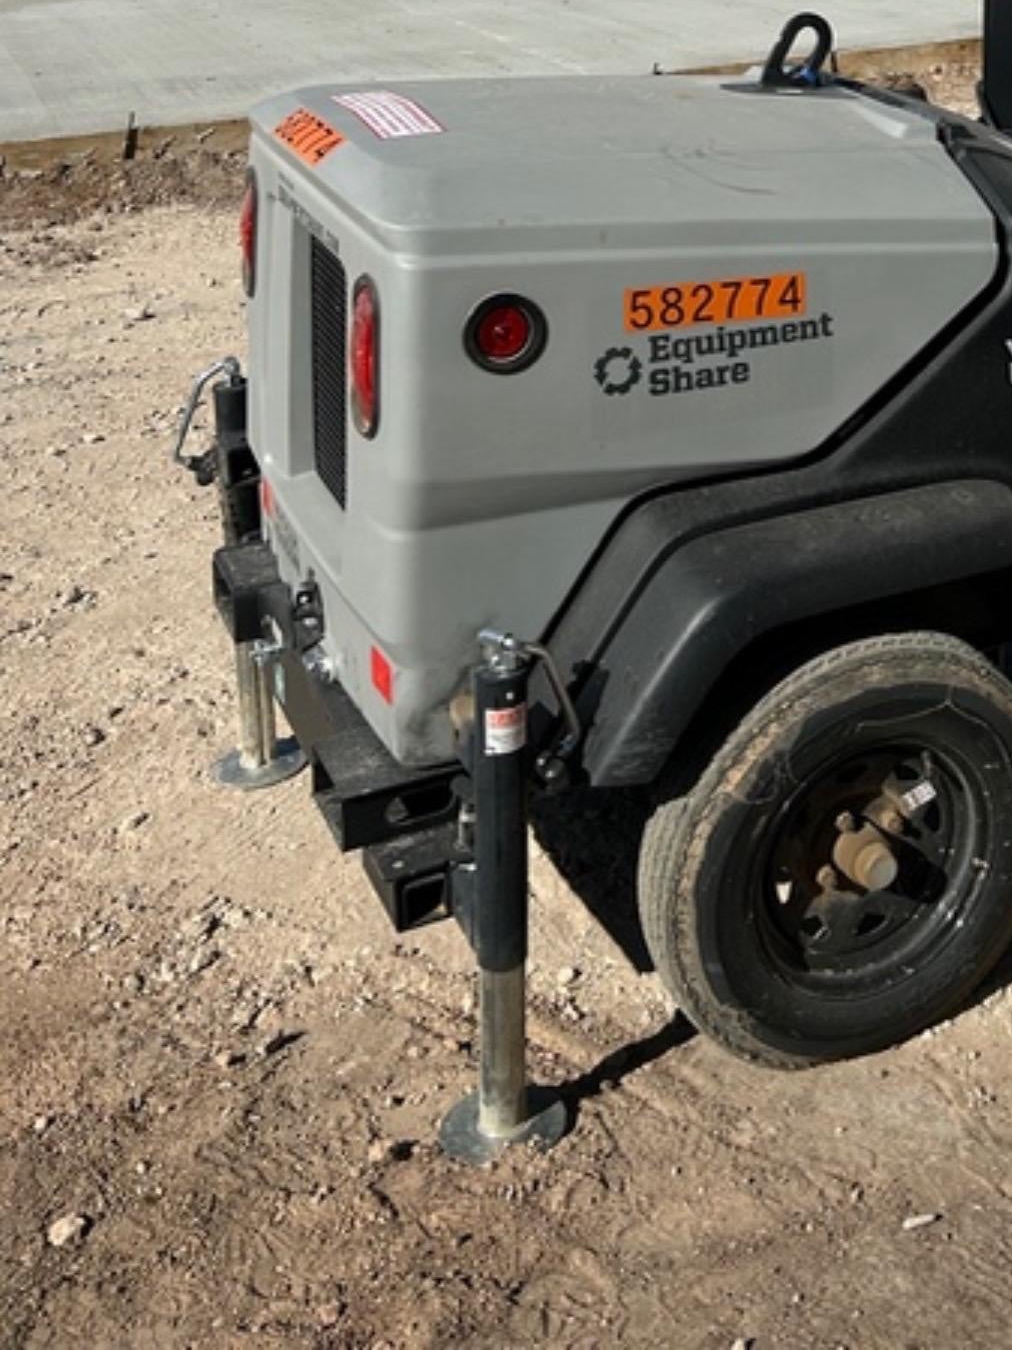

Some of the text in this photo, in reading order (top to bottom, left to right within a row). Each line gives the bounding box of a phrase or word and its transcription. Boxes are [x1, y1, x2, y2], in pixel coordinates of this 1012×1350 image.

[629, 276, 801, 329] 582774
[648, 312, 833, 363] Equipment
[649, 362, 750, 396] Share
